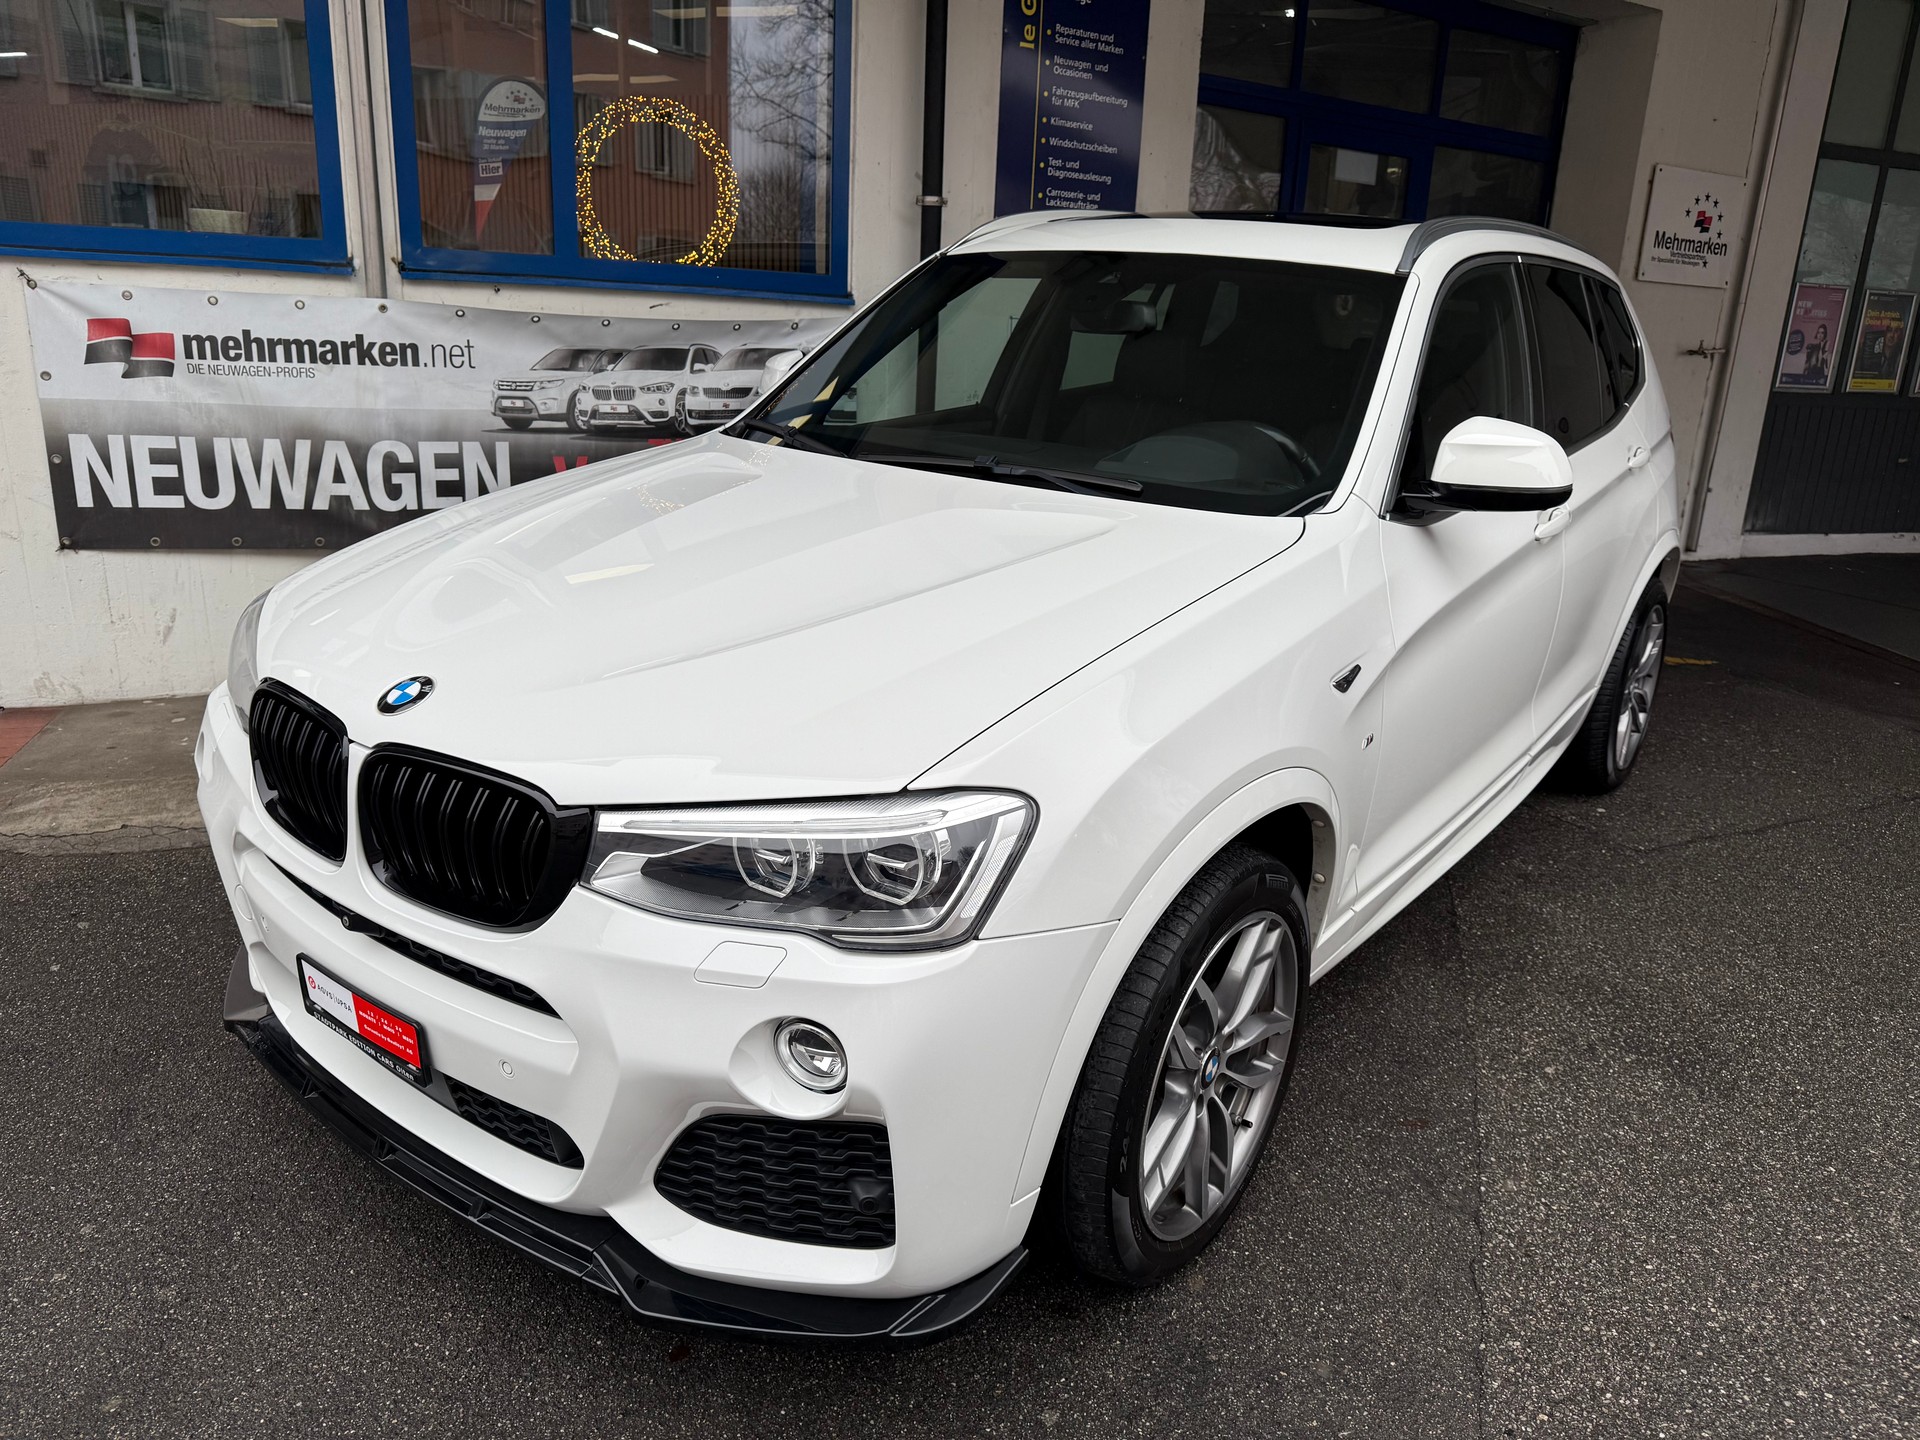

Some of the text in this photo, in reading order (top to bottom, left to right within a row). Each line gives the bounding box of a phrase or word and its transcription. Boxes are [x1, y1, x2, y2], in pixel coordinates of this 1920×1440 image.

[1055, 23, 1115, 43] Reparaturen und
[1054, 33, 1124, 55] Service aller Marken
[1053, 55, 1109, 73] Neuwagen und
[1053, 66, 1093, 80] Occasionen
[1052, 85, 1128, 108] Fahrzeugaufbereitung
[1052, 96, 1080, 108] für MFK
[484, 103, 541, 113] Mehrmarken
[478, 126, 527, 139] Neuwagen
[1050, 116, 1093, 131] Klimaservice
[1049, 136, 1118, 154] Windschutzscheiben
[480, 164, 502, 175] Hier
[1048, 157, 1080, 169] Test- und
[1047, 167, 1112, 185] Diagnoseauslesung
[1046, 187, 1101, 201] Carrosserie- und
[1653, 230, 1728, 256] Mehrmarken
[182, 329, 476, 370] mehrmarken.net
[187, 363, 316, 379] DIE NEUWAGEN-PROFIS
[67, 433, 512, 512] NEUWAGEN
[313, 1011, 415, 1081] STADTPARK EDITION CARS Olten
